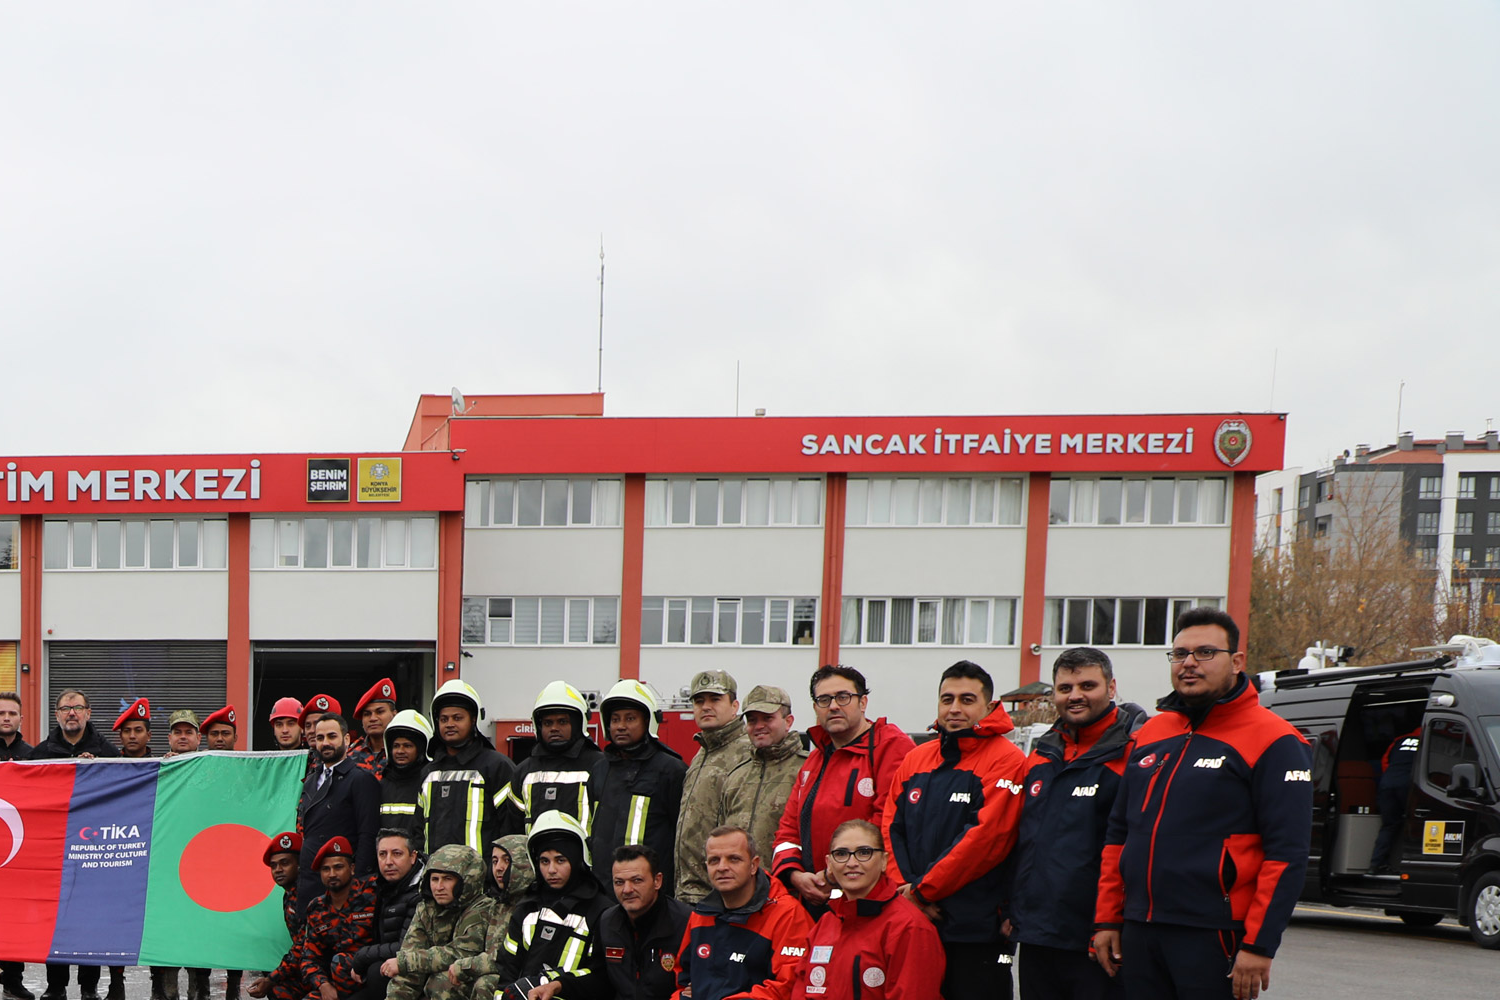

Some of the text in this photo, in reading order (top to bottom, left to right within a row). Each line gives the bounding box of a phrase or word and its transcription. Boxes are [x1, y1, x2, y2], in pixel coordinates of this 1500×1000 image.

[801, 427, 1194, 456] SANCAK İTFAİYE MERKEZİ
[67, 459, 261, 501] MERKEZİ
[1193, 756, 1226, 769] AFAD
[1284, 769, 1311, 782] AFAD
[996, 778, 1023, 795] AFAD
[1071, 784, 1099, 796] AFAD
[100, 824, 140, 840] TİKA
[118, 842, 146, 850] TURKEY
[115, 850, 148, 859] CULTURE
[100, 860, 132, 868] TOURISM
